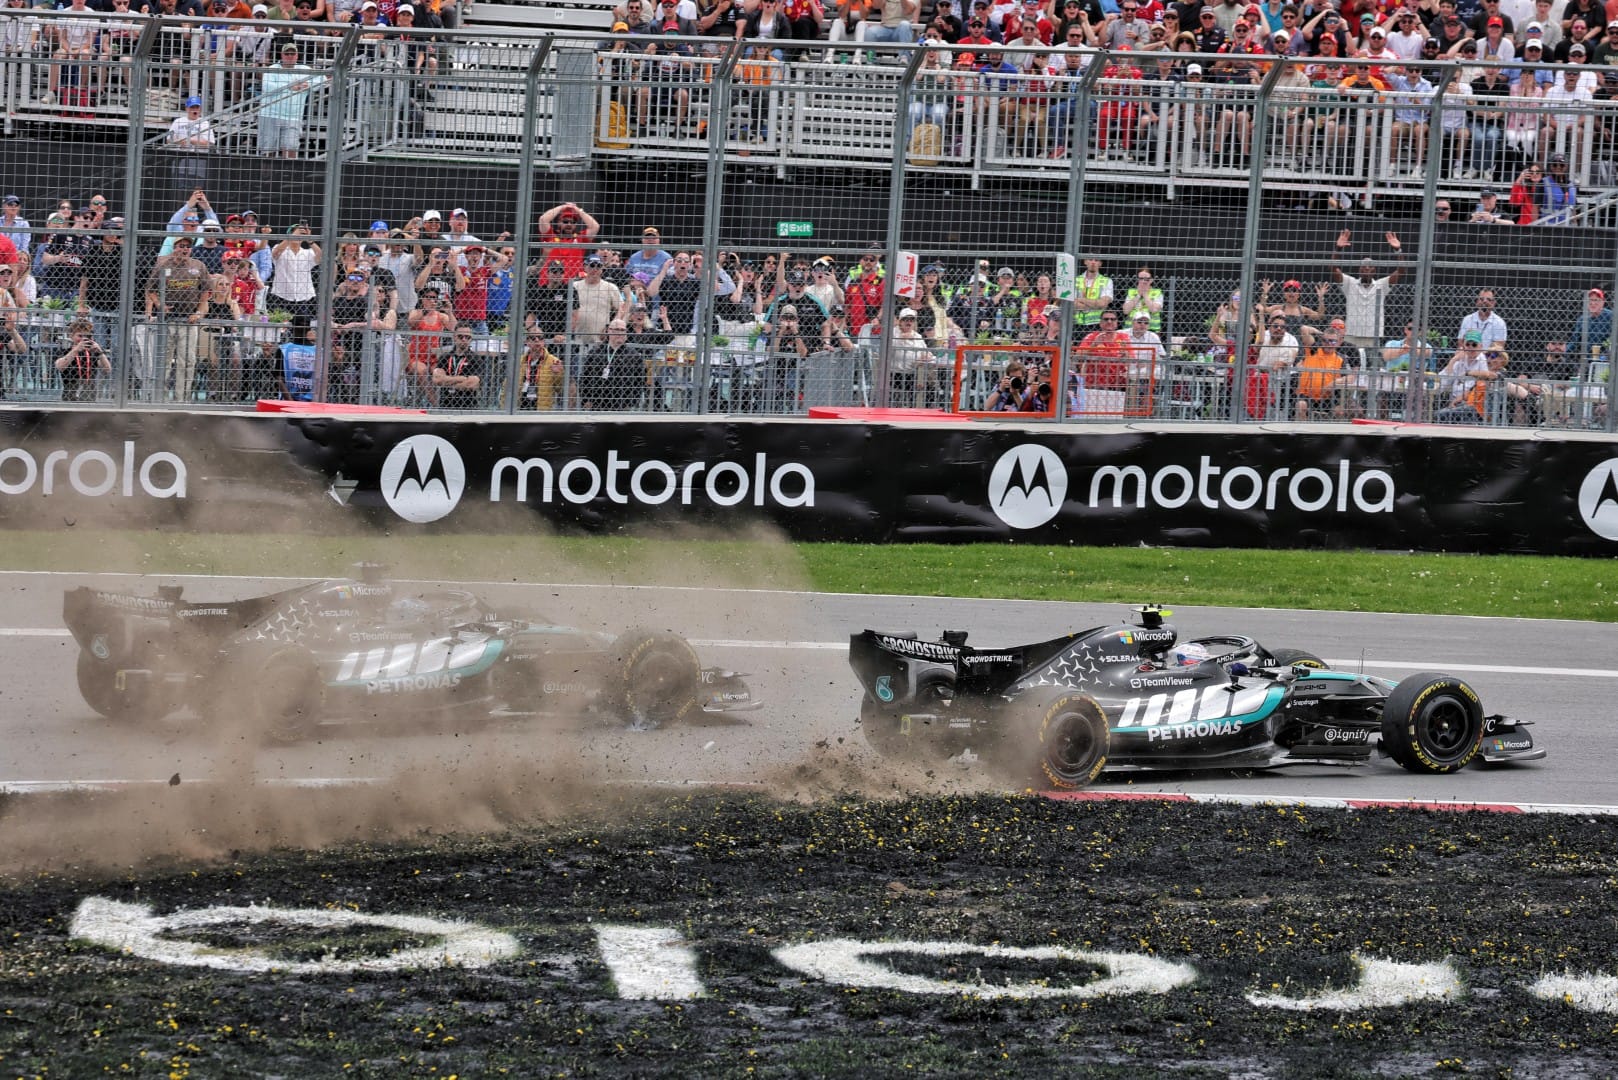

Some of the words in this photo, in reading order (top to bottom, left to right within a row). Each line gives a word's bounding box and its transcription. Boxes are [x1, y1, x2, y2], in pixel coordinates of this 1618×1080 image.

[789, 224, 811, 232] Exit
[896, 274, 914, 285] FIRE
[1057, 277, 1073, 288] EXIT
[490, 449, 815, 507] motorola
[1088, 456, 1394, 513] motorola
[180, 608, 228, 617] CROWDSTRIKE
[360, 632, 413, 641] TeamViewer
[1133, 631, 1173, 641] Microsoft
[882, 637, 961, 660] CROWDSTRIKE
[367, 673, 462, 695] PETRONAS
[1143, 677, 1193, 687] TeamViewer
[1148, 720, 1243, 742] PETRONAS
[1503, 740, 1530, 748] Microsoft
